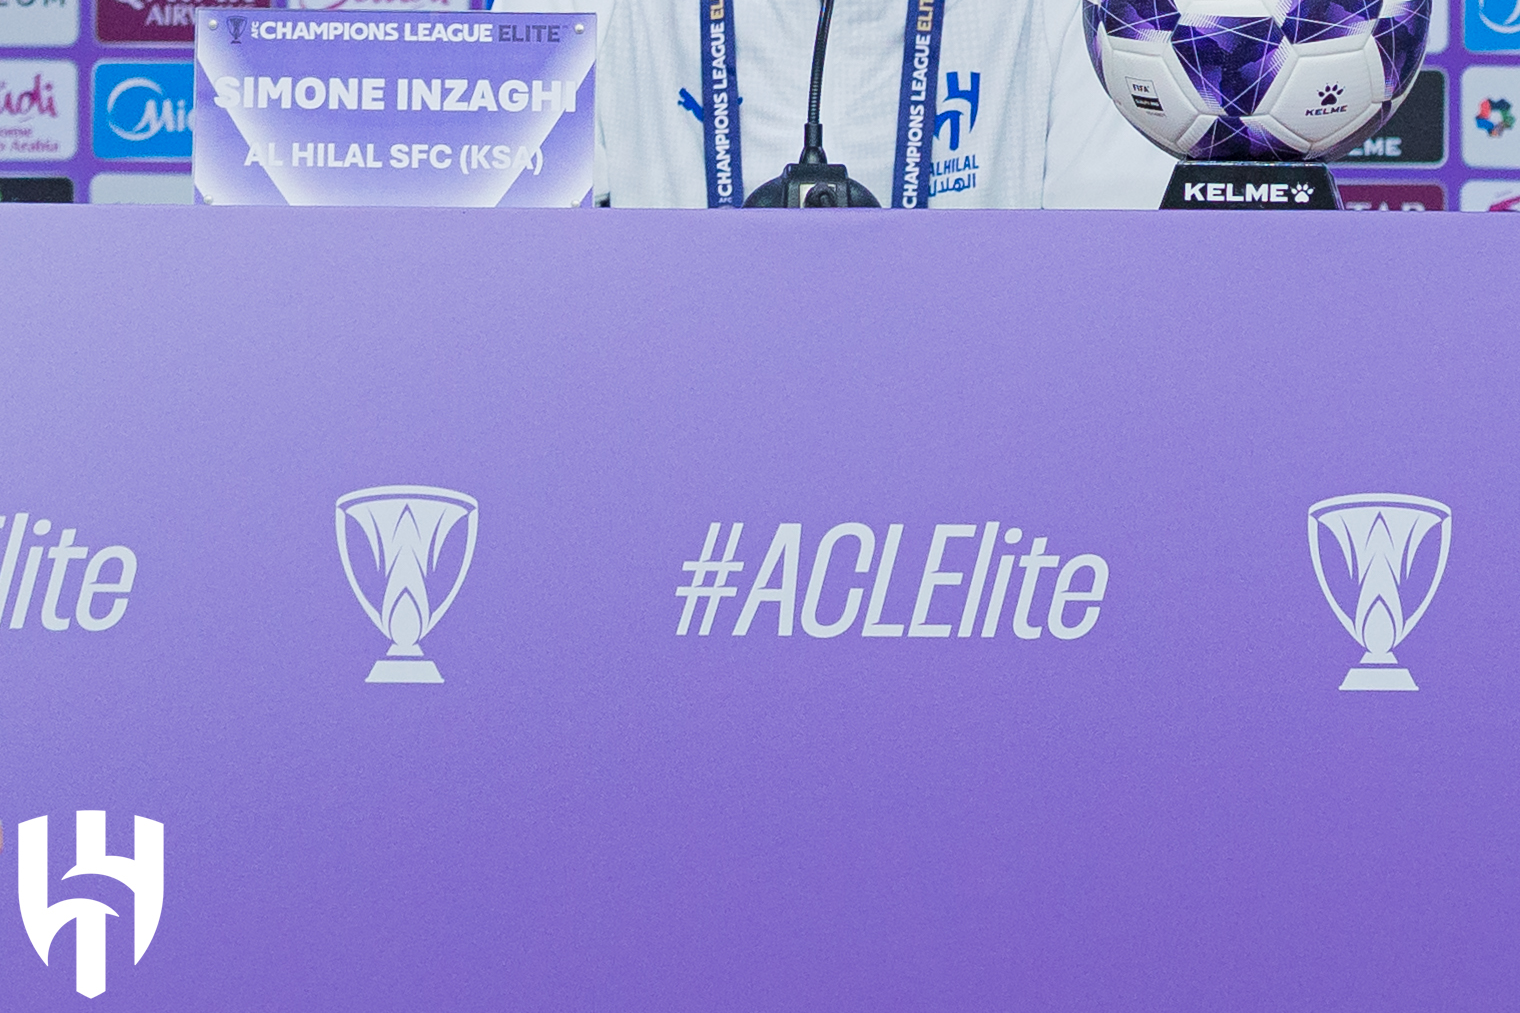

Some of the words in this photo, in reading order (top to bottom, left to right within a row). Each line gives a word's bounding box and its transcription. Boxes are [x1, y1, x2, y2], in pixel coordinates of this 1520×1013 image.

[260, 21, 398, 42] CHAMPIONS
[404, 23, 493, 43] LEAGUE
[710, 21, 728, 90] LEAGUE
[214, 76, 385, 111] SIMONE
[396, 78, 578, 113] INZAGHI
[912, 34, 931, 103] LEAGUE
[714, 93, 733, 197] CHAMPIONS
[1305, 104, 1348, 117] KELME
[244, 142, 284, 167] AL
[291, 143, 382, 168] HILAL
[390, 144, 452, 169] SFC
[459, 144, 544, 175] (KSA)
[902, 104, 925, 209] CHAMPIONS
[1183, 182, 1289, 203] KELME
[0, 512, 138, 632] lite
[675, 521, 1111, 641] #ACLElite
